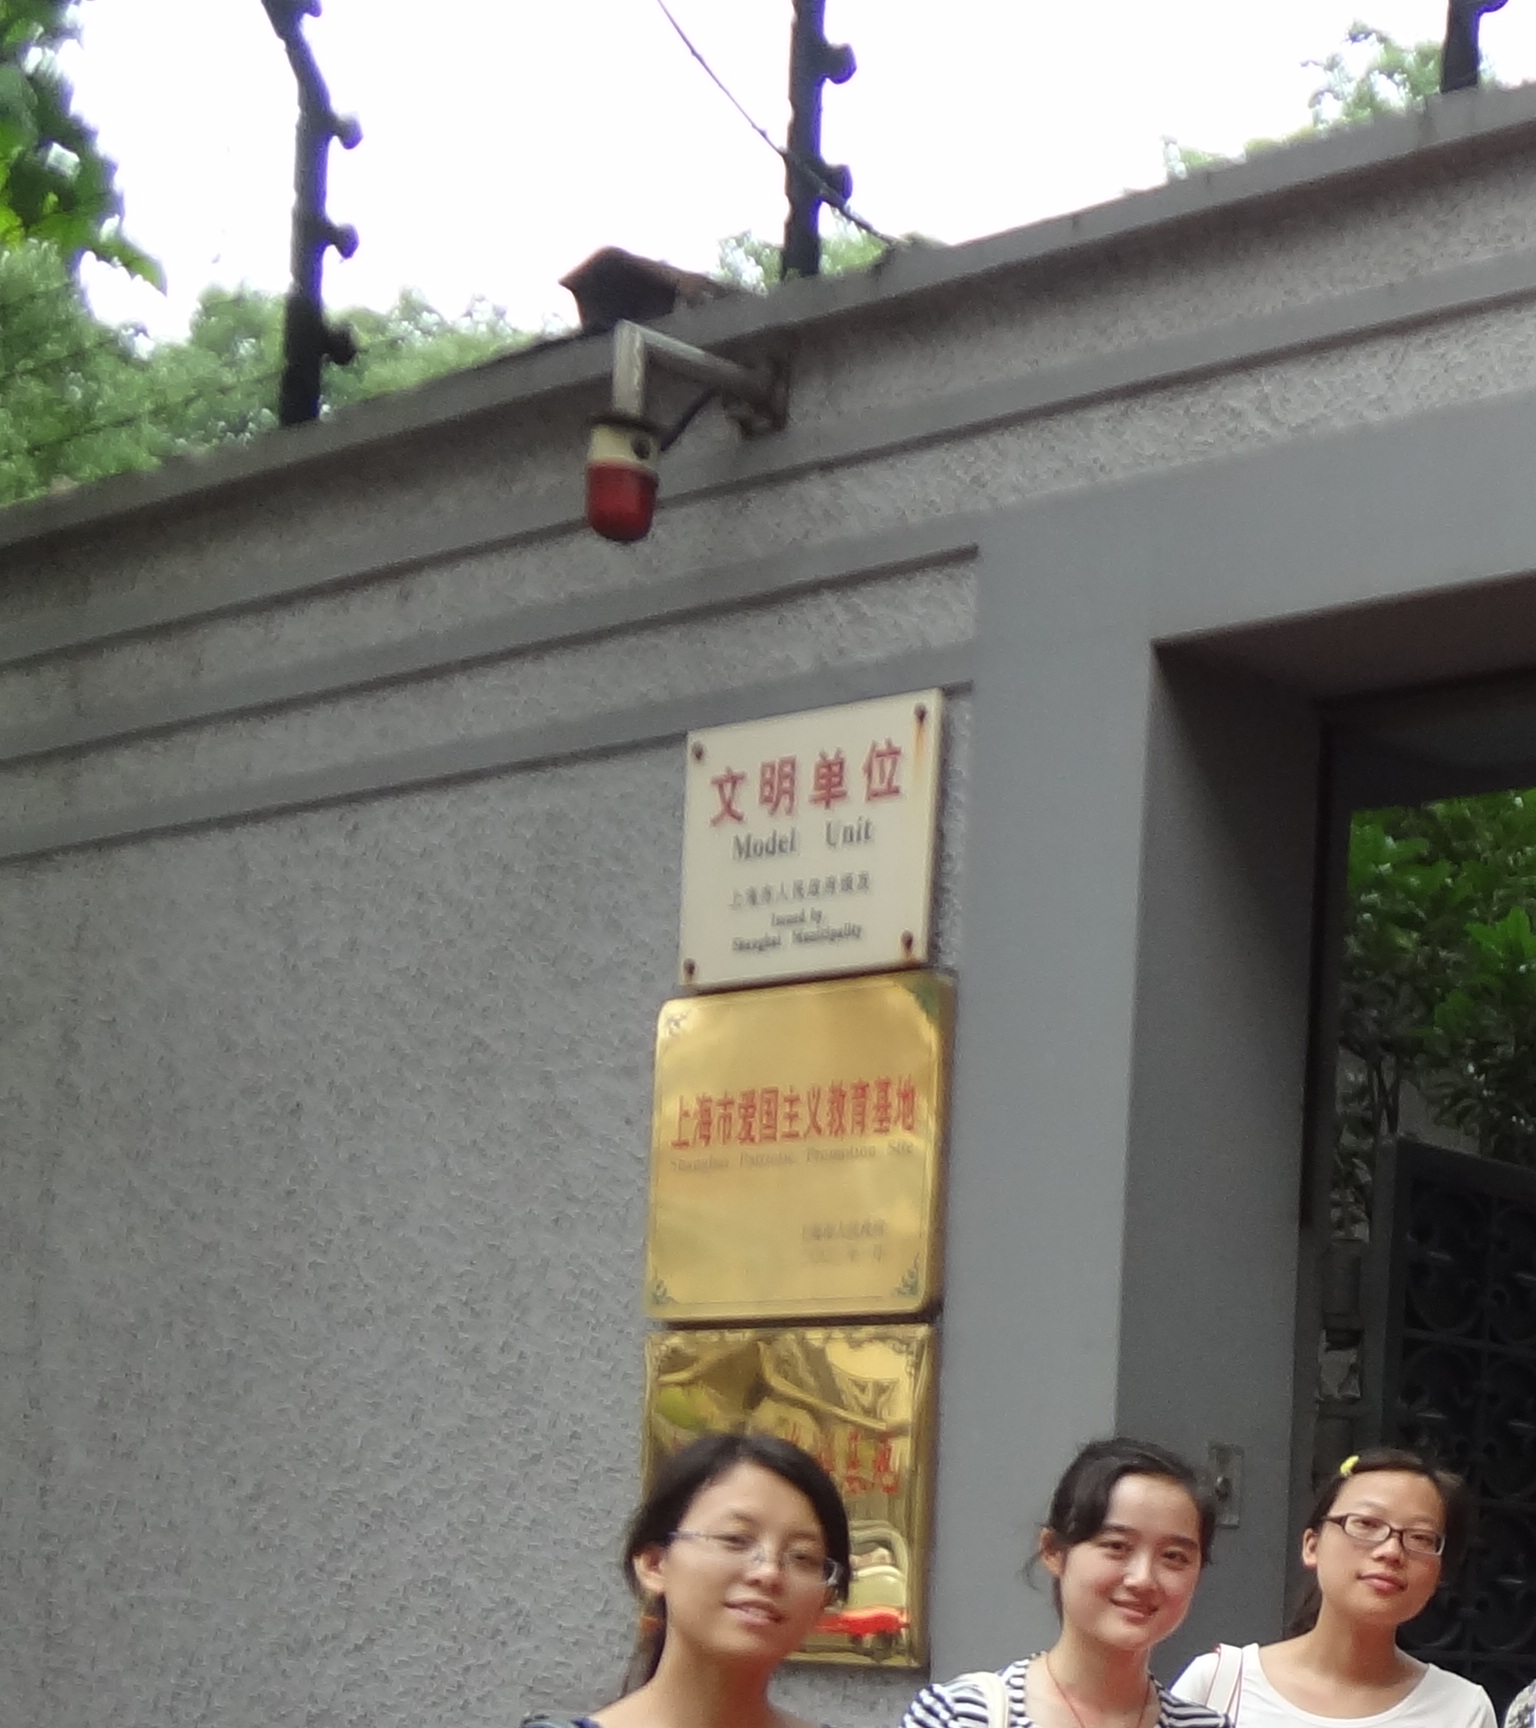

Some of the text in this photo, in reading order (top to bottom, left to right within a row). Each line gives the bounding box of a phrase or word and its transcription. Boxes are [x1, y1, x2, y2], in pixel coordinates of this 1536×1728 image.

[710, 737, 903, 827] 文明单位
[733, 815, 873, 861] Model Unit
[670, 1074, 917, 1148] 上海市爱国主义教育基地
